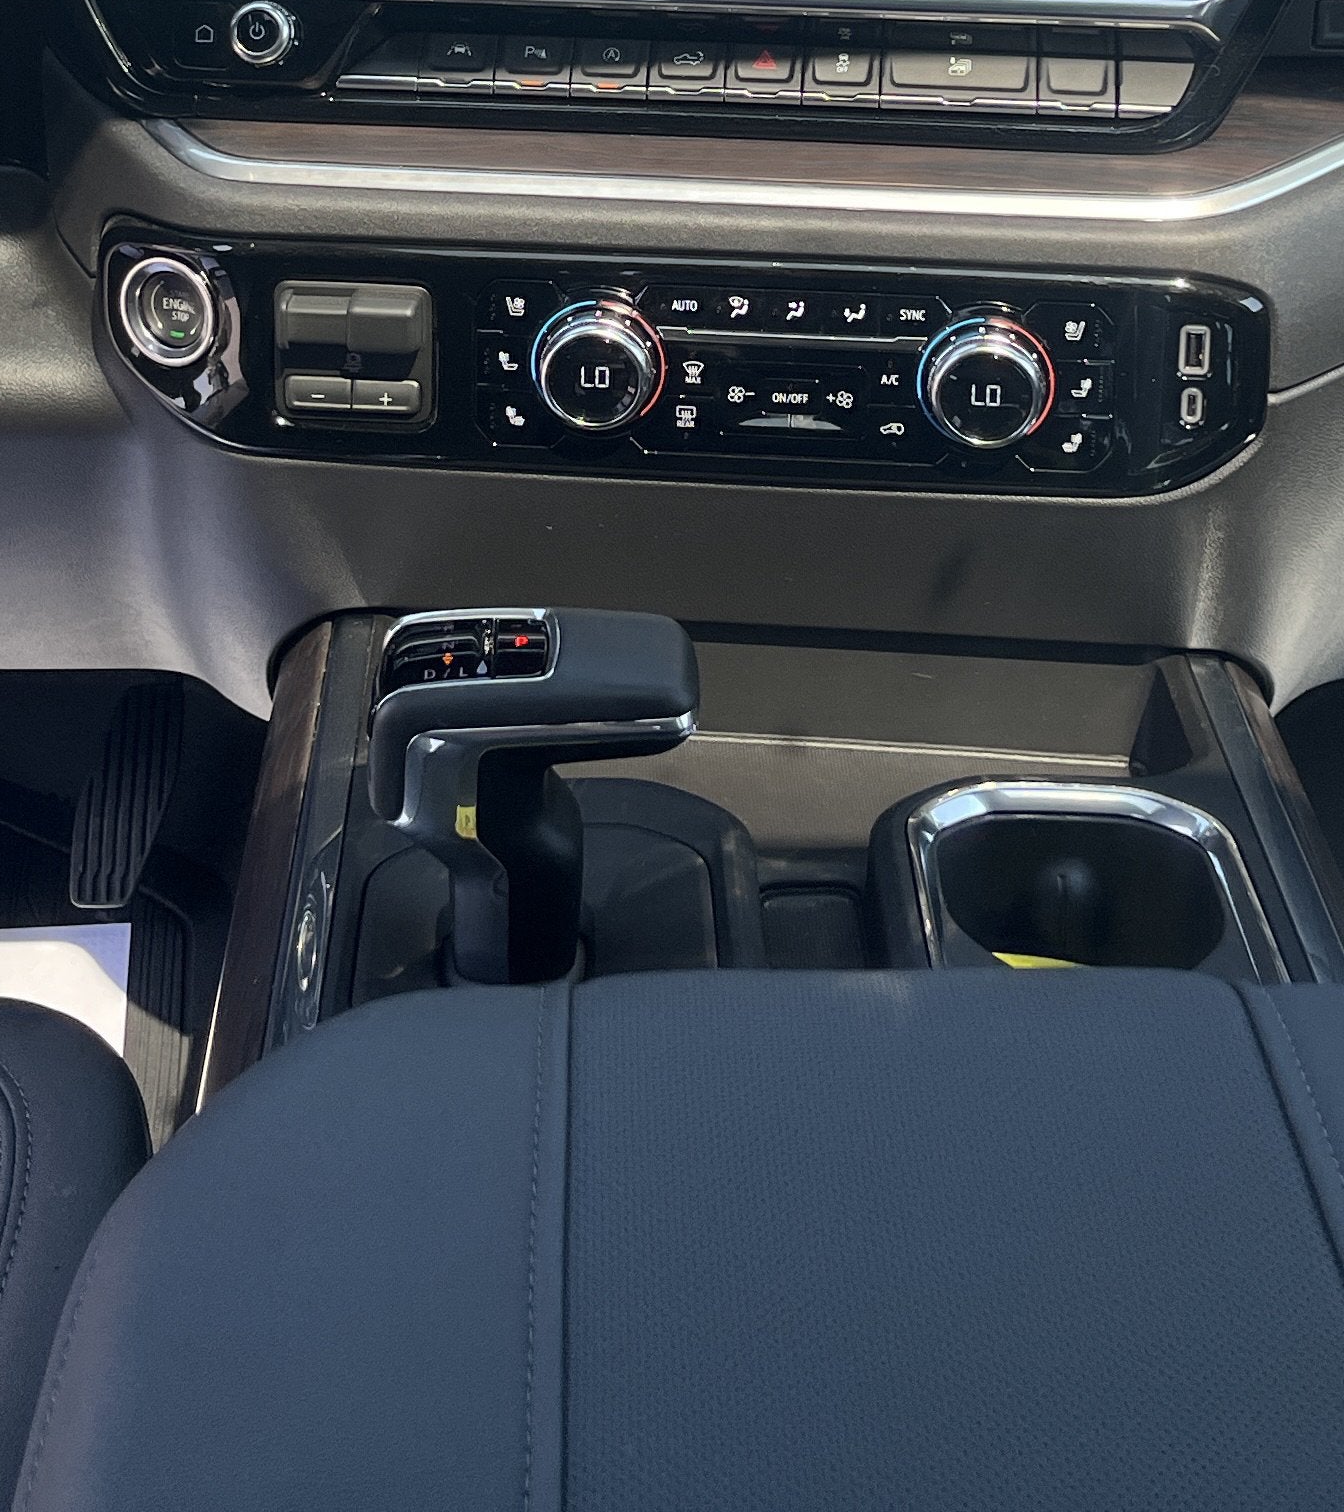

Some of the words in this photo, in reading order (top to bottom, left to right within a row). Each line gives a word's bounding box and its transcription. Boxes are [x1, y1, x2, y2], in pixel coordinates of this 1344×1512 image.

[671, 299, 698, 312] AUTO
[171, 311, 190, 323] STOP
[899, 308, 927, 322] SYNC
[580, 366, 610, 388] LO
[881, 374, 900, 386] A/C
[772, 393, 809, 404] ON/OFF
[971, 384, 1002, 407] LO
[515, 635, 529, 647] P
[424, 669, 436, 680] D
[459, 667, 469, 678] L
